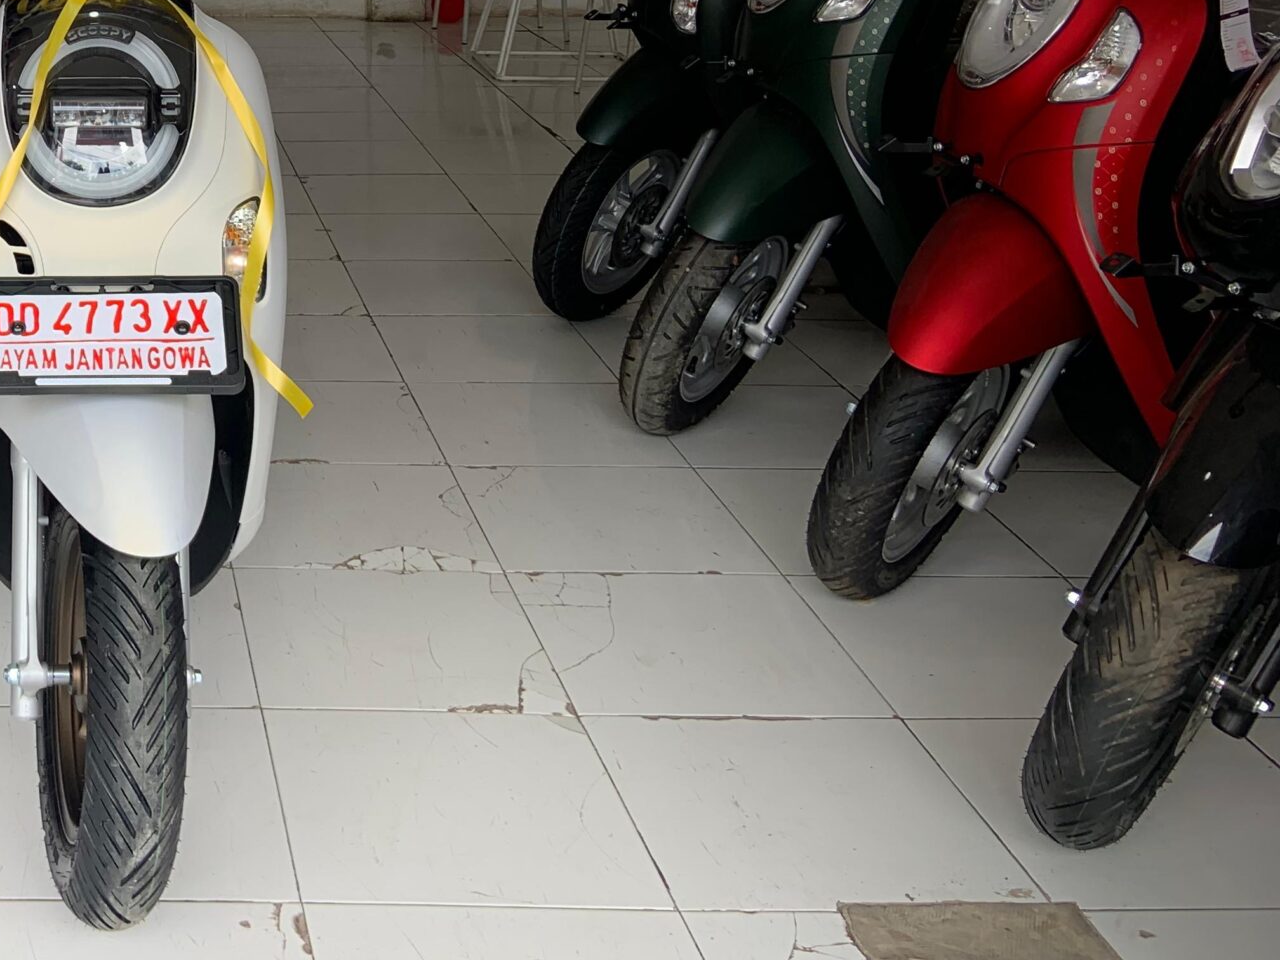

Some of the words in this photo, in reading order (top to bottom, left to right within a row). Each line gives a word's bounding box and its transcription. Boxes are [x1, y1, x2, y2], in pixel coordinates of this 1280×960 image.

[66, 24, 131, 42] SCOOPY
[52, 298, 153, 336] 4773
[162, 297, 210, 335] XX
[0, 346, 58, 371] AYAM
[64, 346, 142, 371] JANTAN
[147, 345, 212, 370] GOWA
